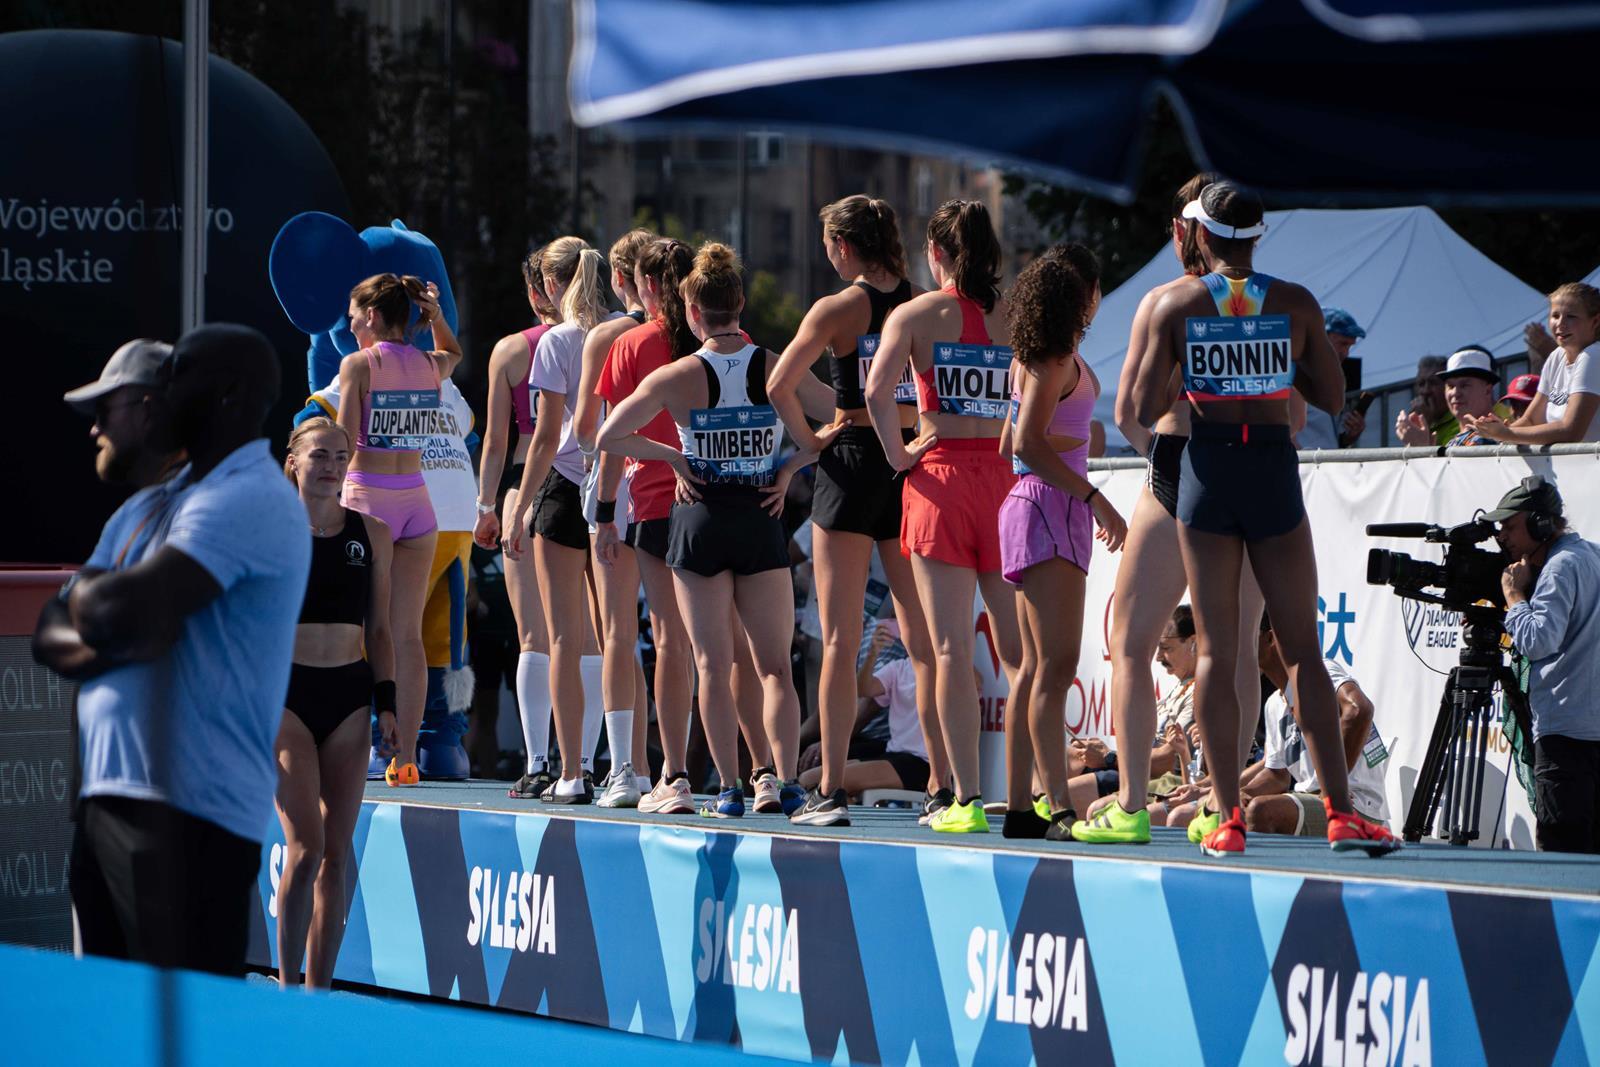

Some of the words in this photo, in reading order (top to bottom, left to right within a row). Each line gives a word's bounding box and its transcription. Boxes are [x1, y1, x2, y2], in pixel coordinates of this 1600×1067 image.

[1190, 341, 1288, 376] BONNIN
[1221, 378, 1277, 393] SILESIA
[371, 409, 438, 435] DUPLANTIS
[963, 400, 1006, 416] SILESIA
[693, 428, 774, 459] TIMBERG
[720, 461, 767, 474] SILESIA
[1426, 630, 1459, 649] EAGUE
[0, 667, 42, 711] OLL
[466, 865, 556, 955] SILESIA
[696, 898, 800, 994] SILESIA
[964, 926, 1089, 1032] SILESIA
[1283, 962, 1432, 1067] SILESIA
